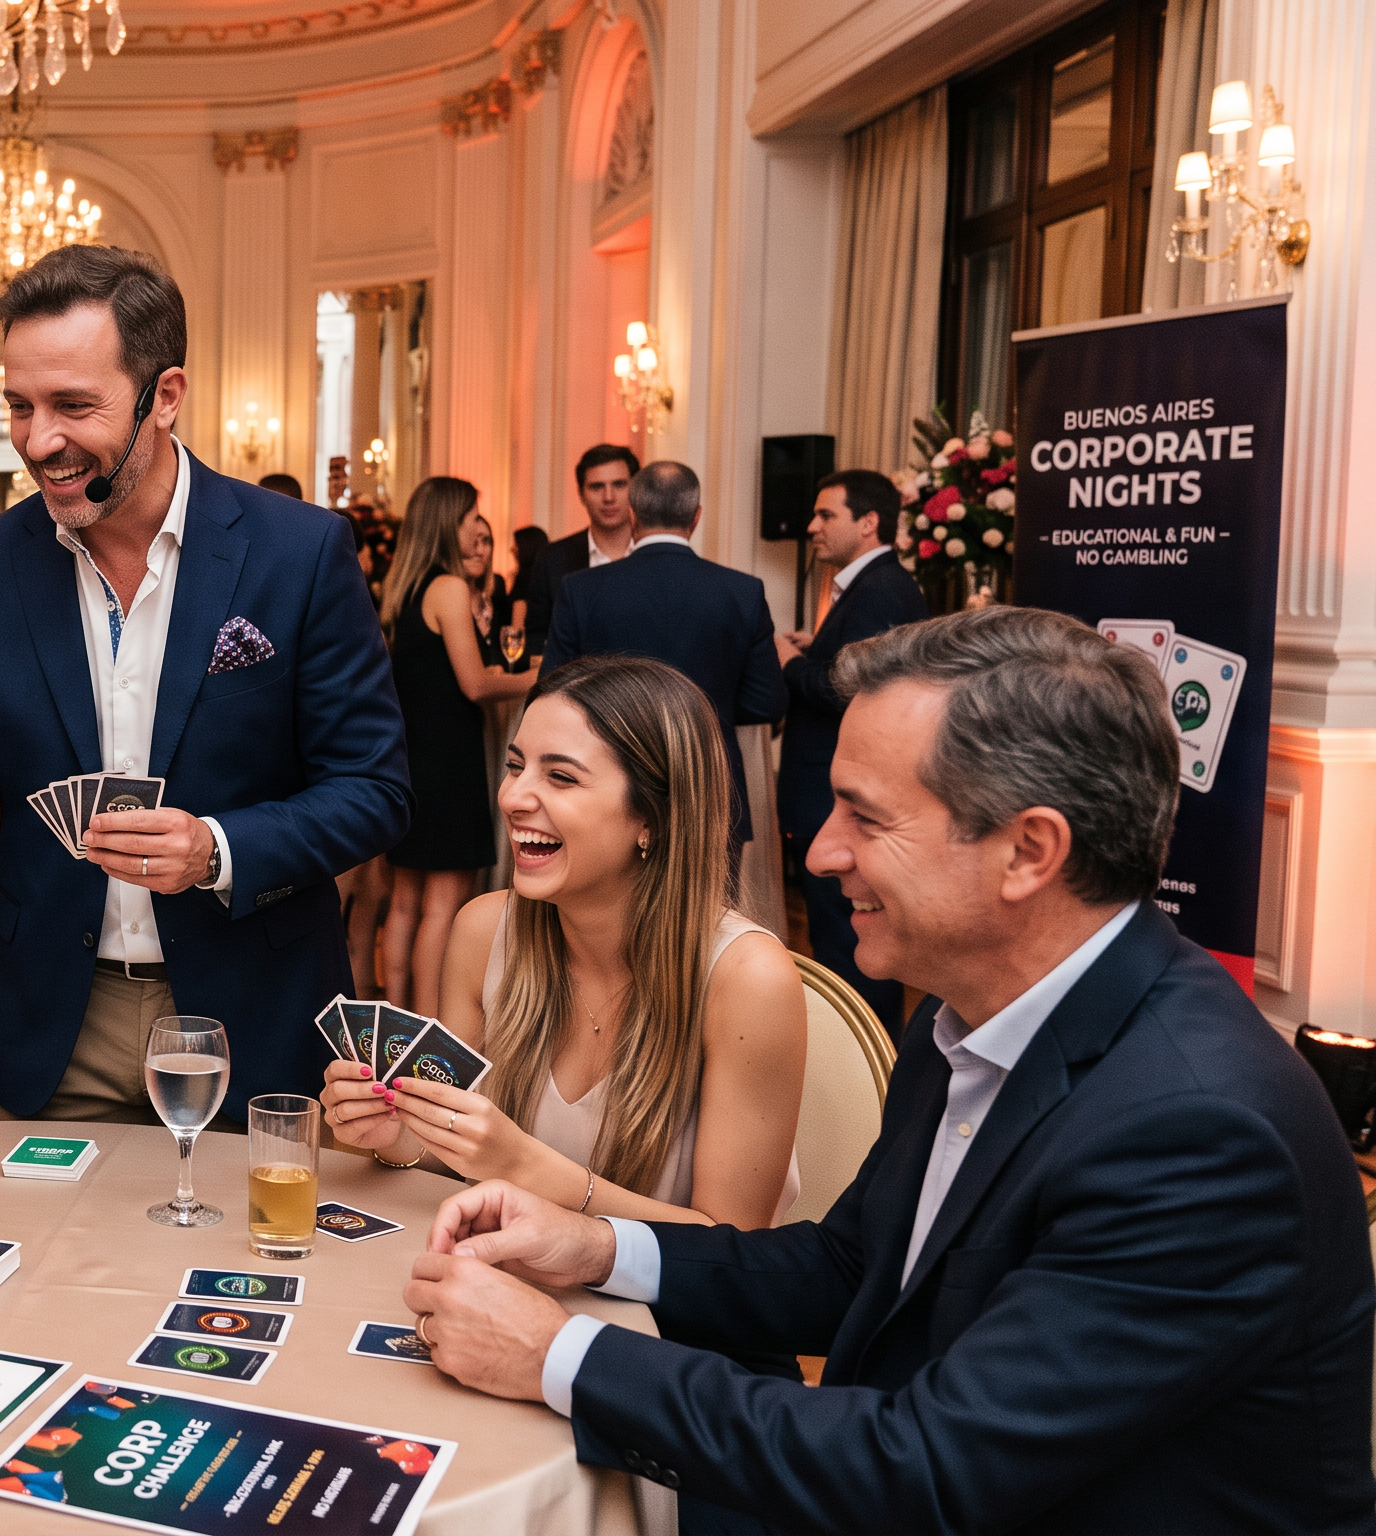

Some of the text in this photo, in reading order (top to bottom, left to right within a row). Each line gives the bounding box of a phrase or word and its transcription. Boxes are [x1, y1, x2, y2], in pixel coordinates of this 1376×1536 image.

[1064, 398, 1215, 430] BUENOS AIRES
[1030, 424, 1254, 472] CORPORATE
[1068, 470, 1202, 508] NIGHTS
[1052, 526, 1215, 545] EDUCATIONAL & FUN
[1076, 548, 1188, 565] NO GAMBLING
[93, 1419, 168, 1486] CORP
[133, 1418, 212, 1499] CHALLENGE
